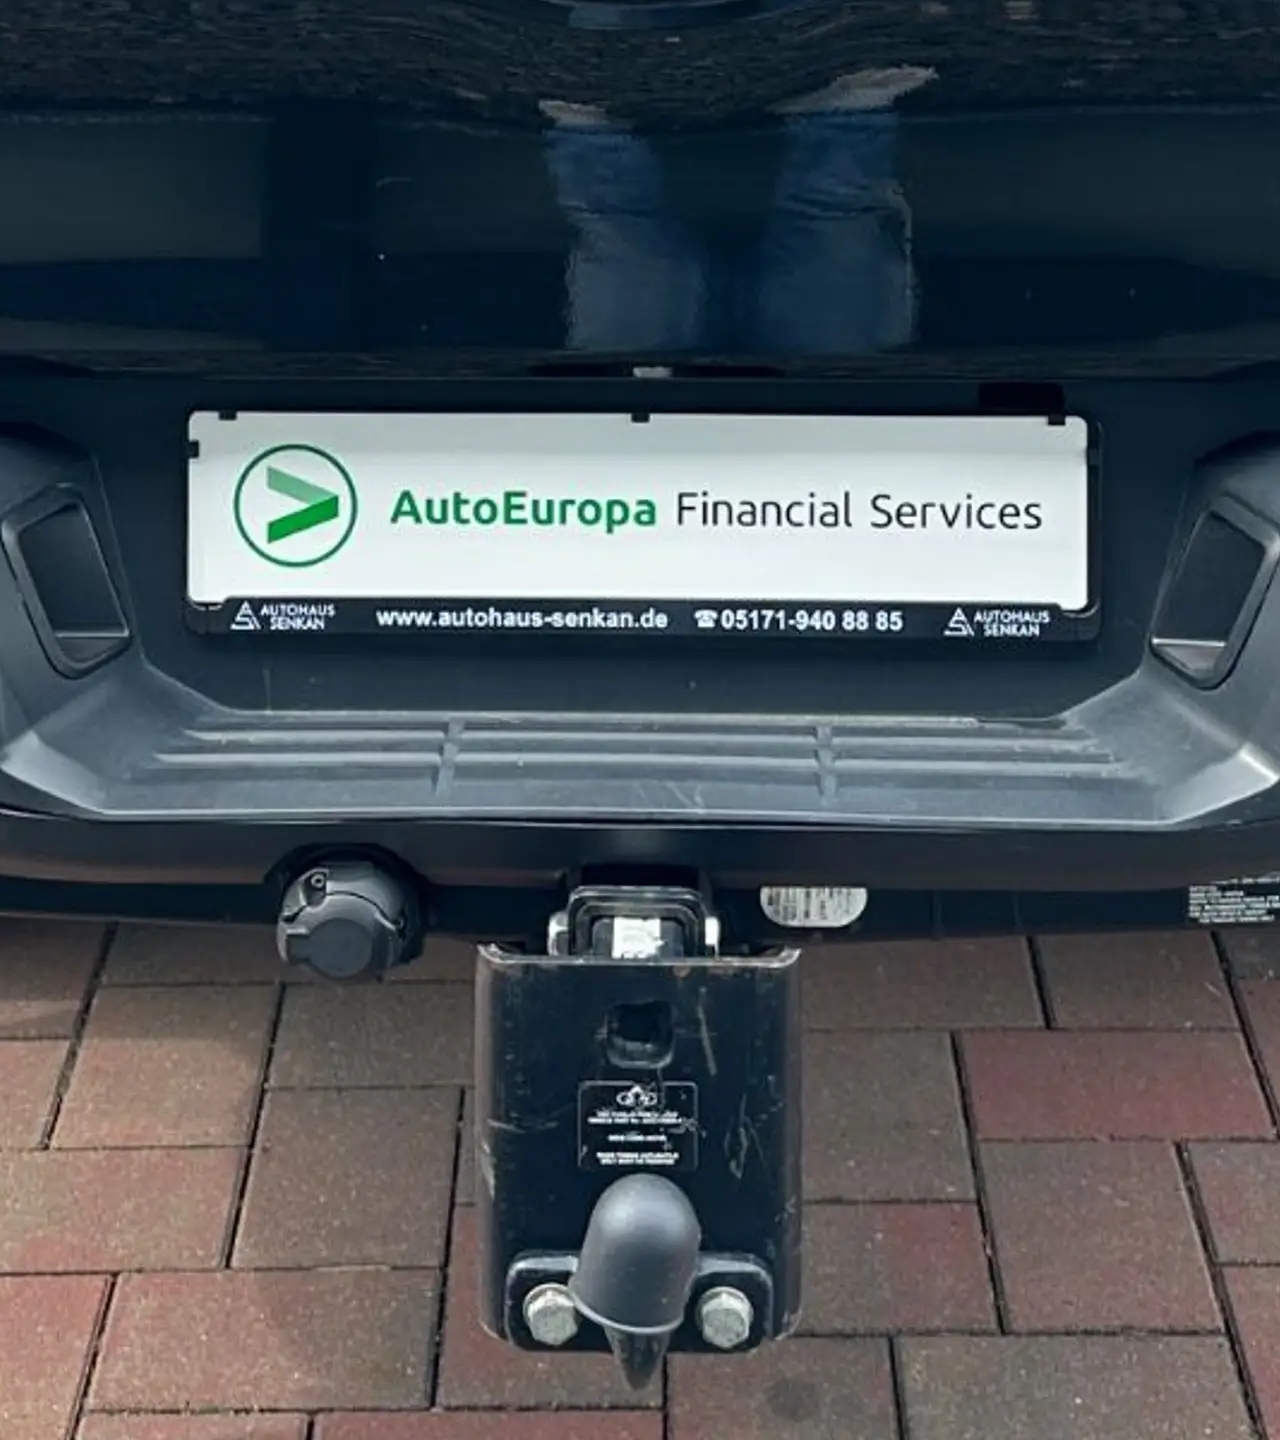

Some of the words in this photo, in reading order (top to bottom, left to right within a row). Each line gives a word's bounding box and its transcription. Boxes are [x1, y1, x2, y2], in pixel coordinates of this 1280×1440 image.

[390, 490, 657, 534] AutoEuropa
[676, 491, 853, 528] Financial
[869, 493, 1043, 530] Services
[260, 603, 336, 617] AUTOHAUS
[974, 609, 1051, 623] AUTOHAUS
[269, 616, 325, 630] SENKAN
[376, 607, 669, 629] www.autohaus-senkan.de
[841, 610, 870, 631] 88
[874, 610, 904, 631] 85
[983, 623, 1040, 637] SENKAN
